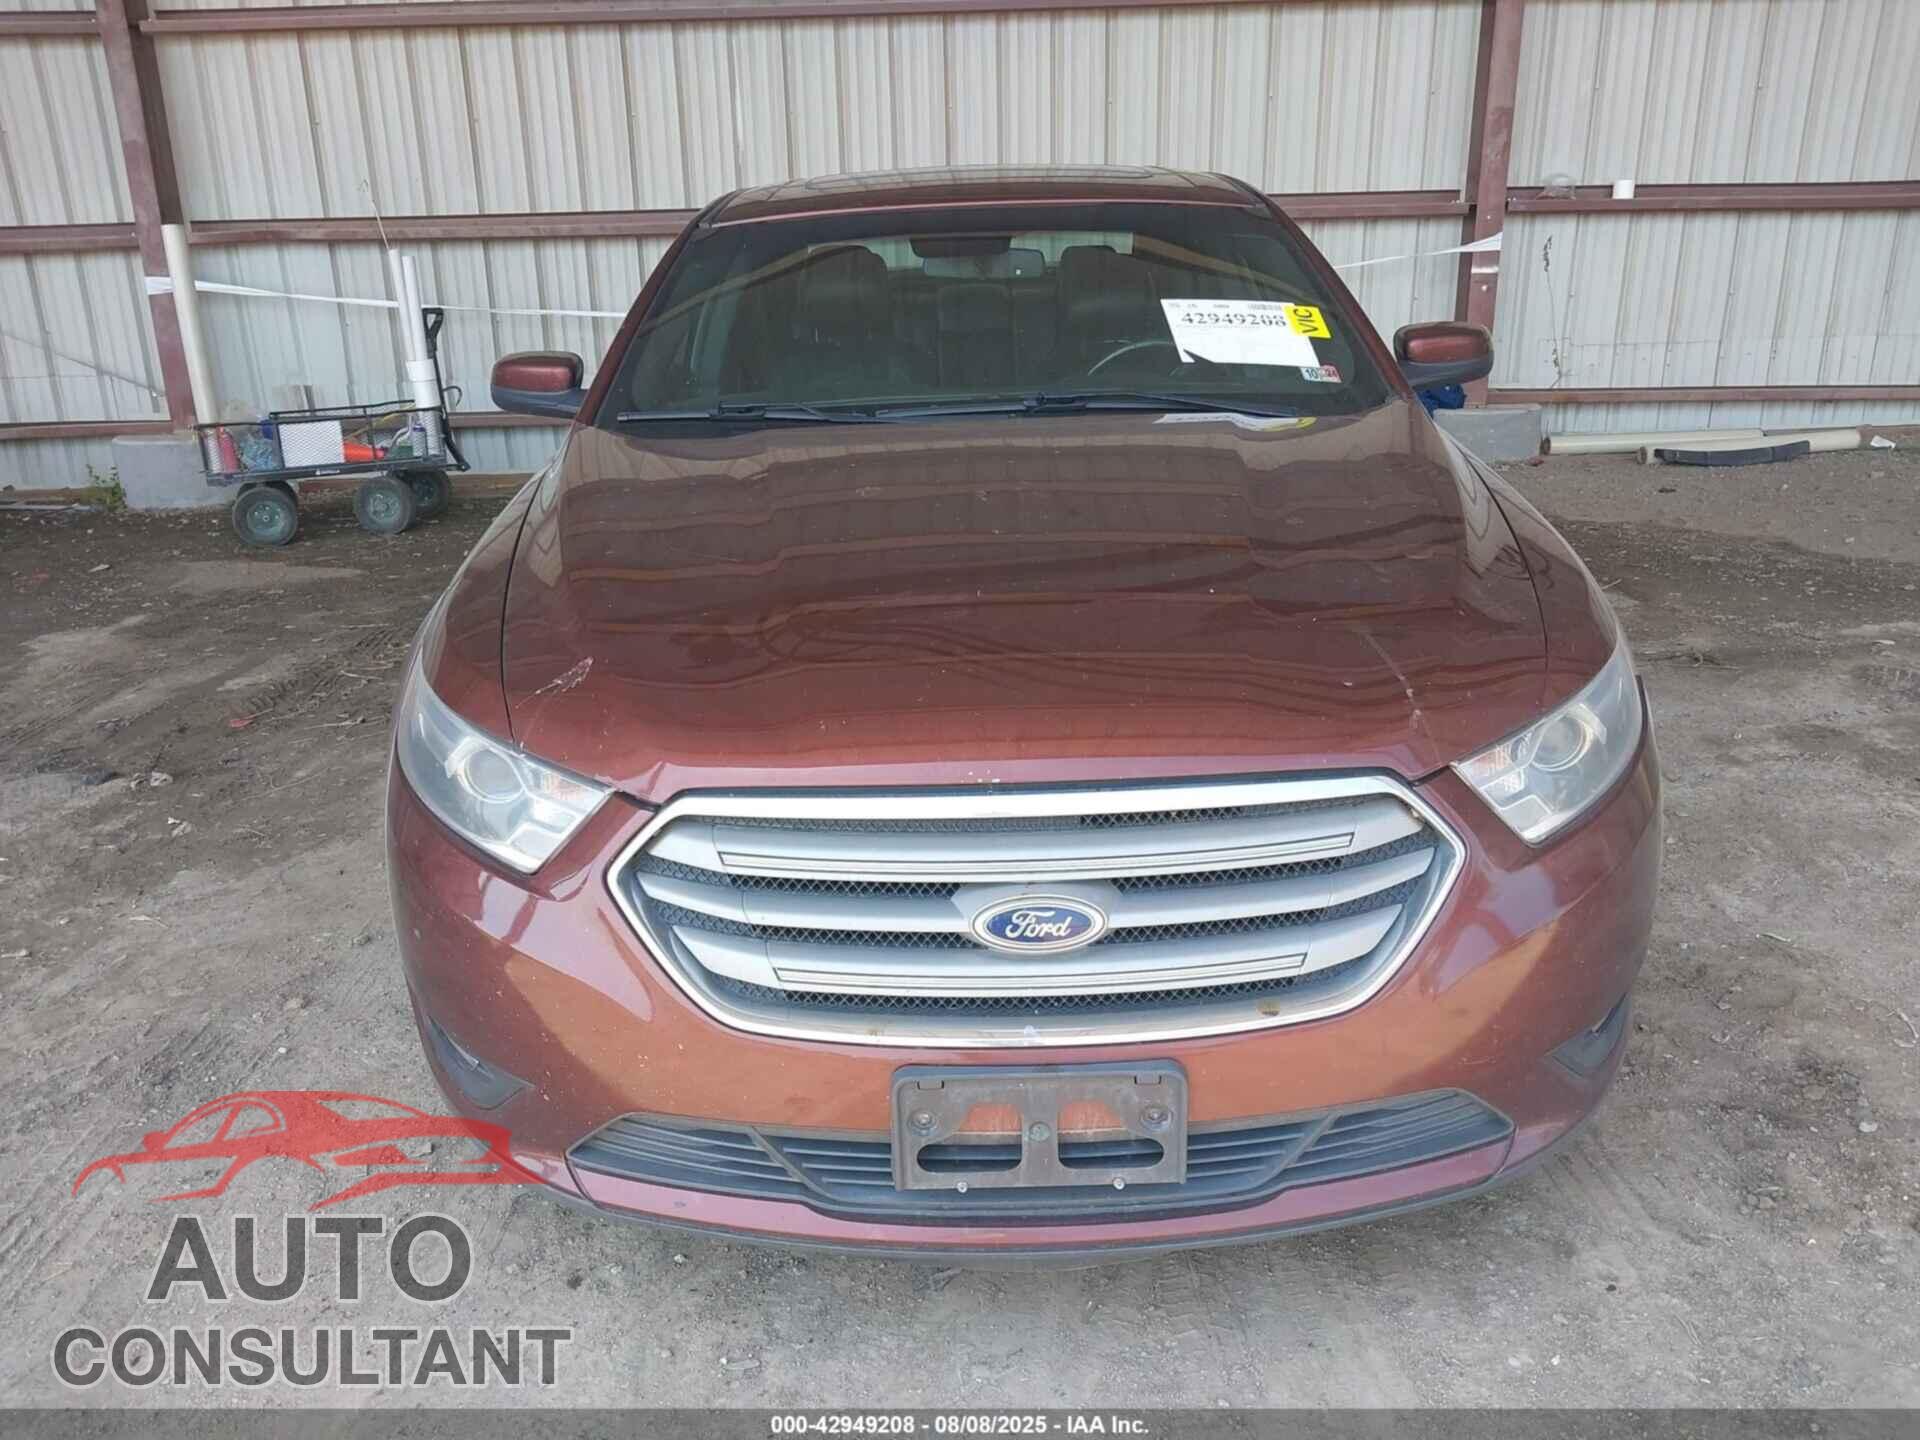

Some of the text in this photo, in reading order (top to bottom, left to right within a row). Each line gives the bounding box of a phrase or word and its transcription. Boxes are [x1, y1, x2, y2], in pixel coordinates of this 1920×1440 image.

[1181, 312, 1287, 327] 42949208
[1293, 307, 1319, 334] VIC
[1004, 909, 1073, 939] Ford
